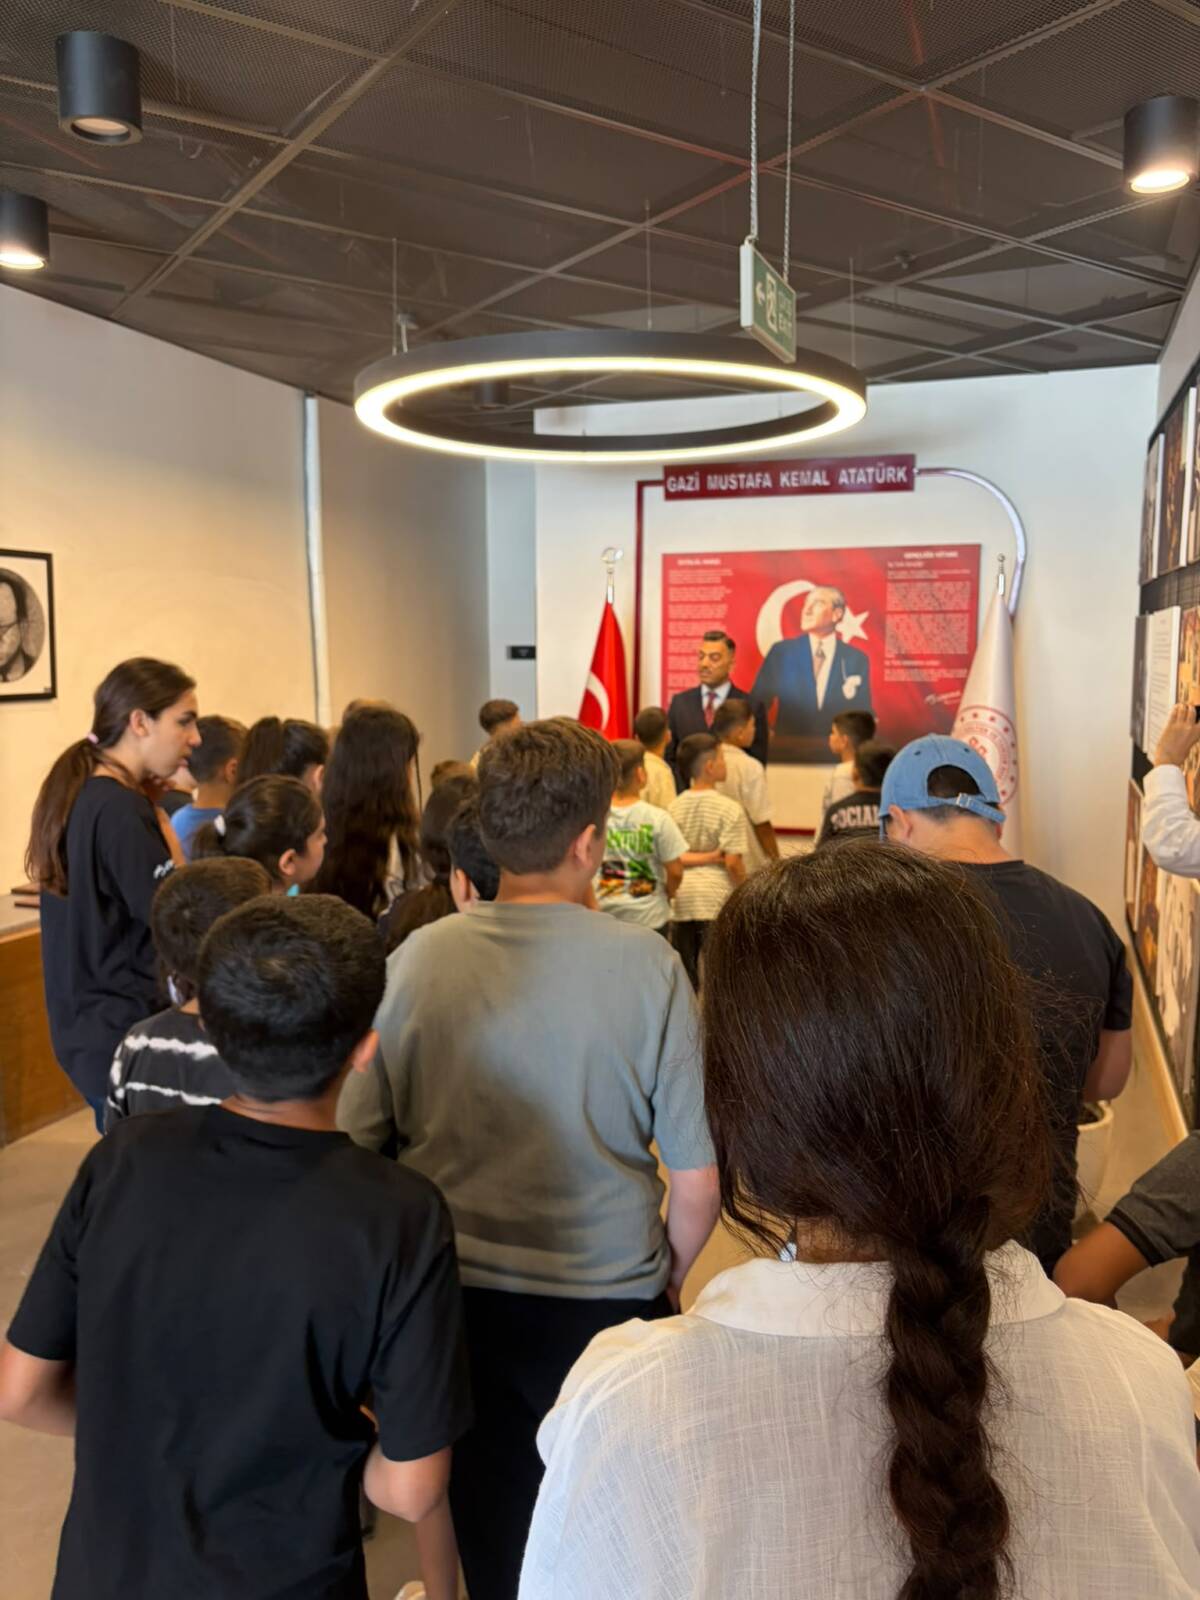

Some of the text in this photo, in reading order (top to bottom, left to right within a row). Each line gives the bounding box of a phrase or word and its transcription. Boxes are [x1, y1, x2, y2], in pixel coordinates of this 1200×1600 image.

[666, 462, 908, 492] GAZİ MUSTAFA KEMAL ATATÜRK
[831, 804, 881, 830] SOCIAL
